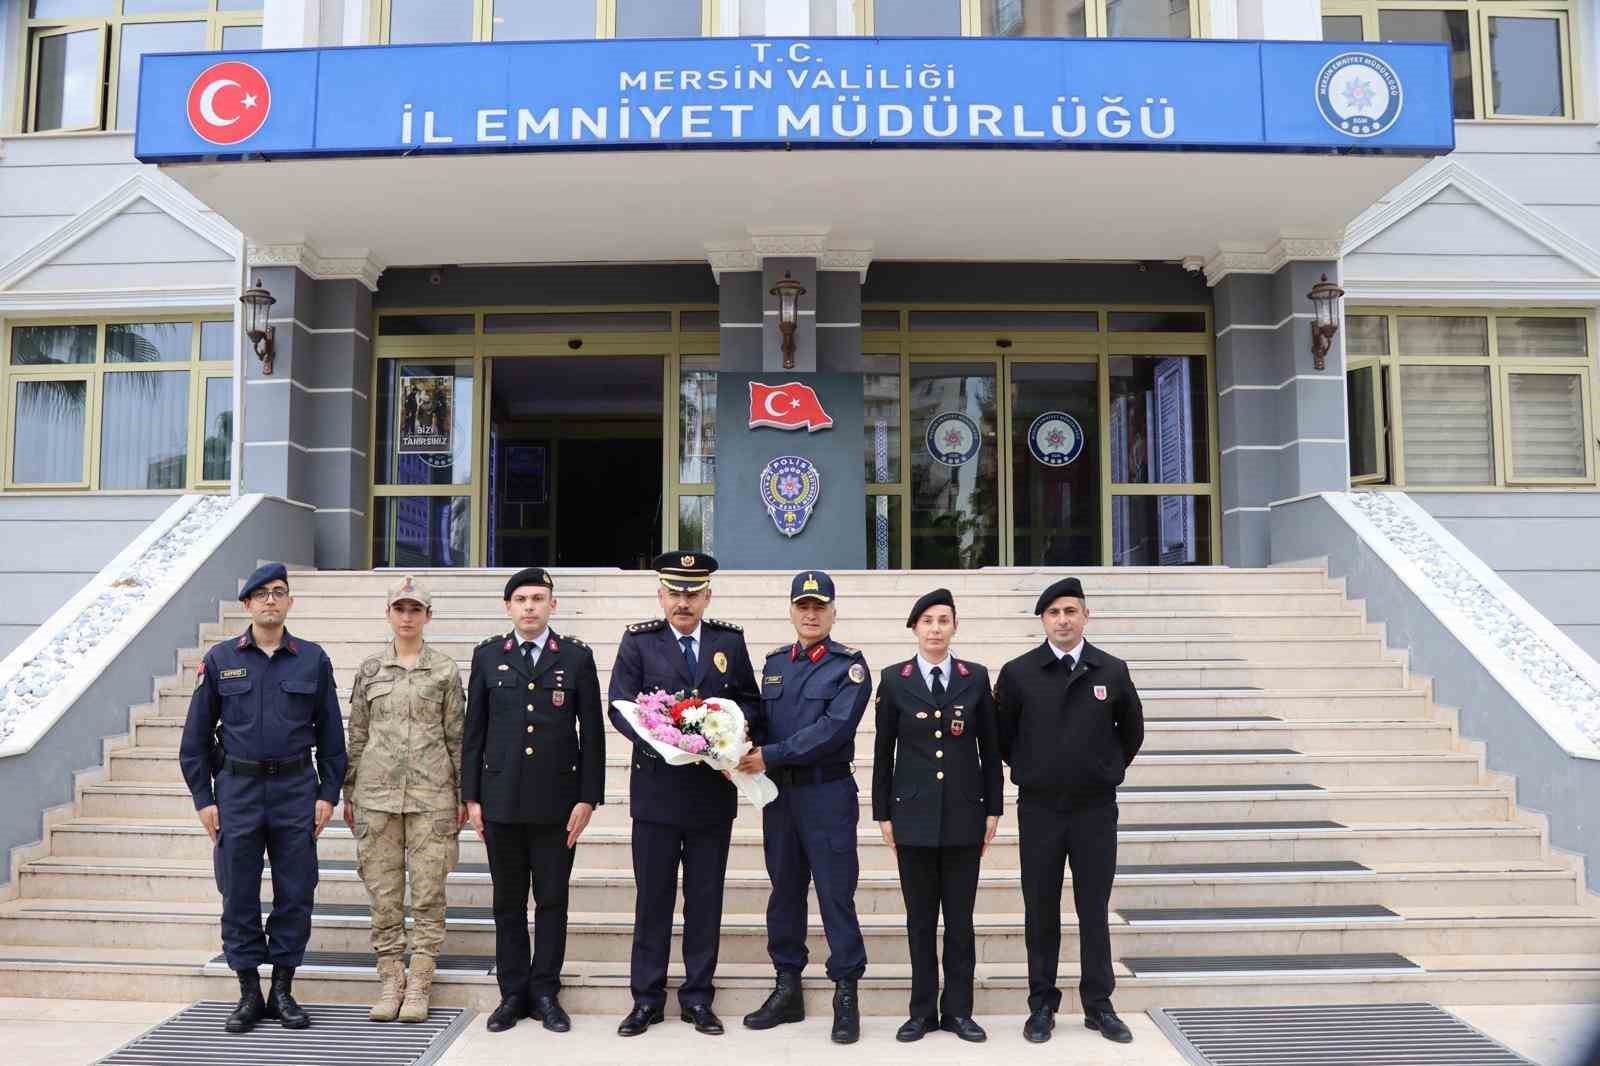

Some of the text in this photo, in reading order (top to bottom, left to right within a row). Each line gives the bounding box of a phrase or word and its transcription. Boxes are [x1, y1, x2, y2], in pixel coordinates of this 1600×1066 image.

[750, 43, 823, 63] T.C.
[619, 63, 956, 91] MERSİN VALİLİĞİ
[402, 95, 1176, 144] İL EMNİYET MÜDÜRLÜĞÜ
